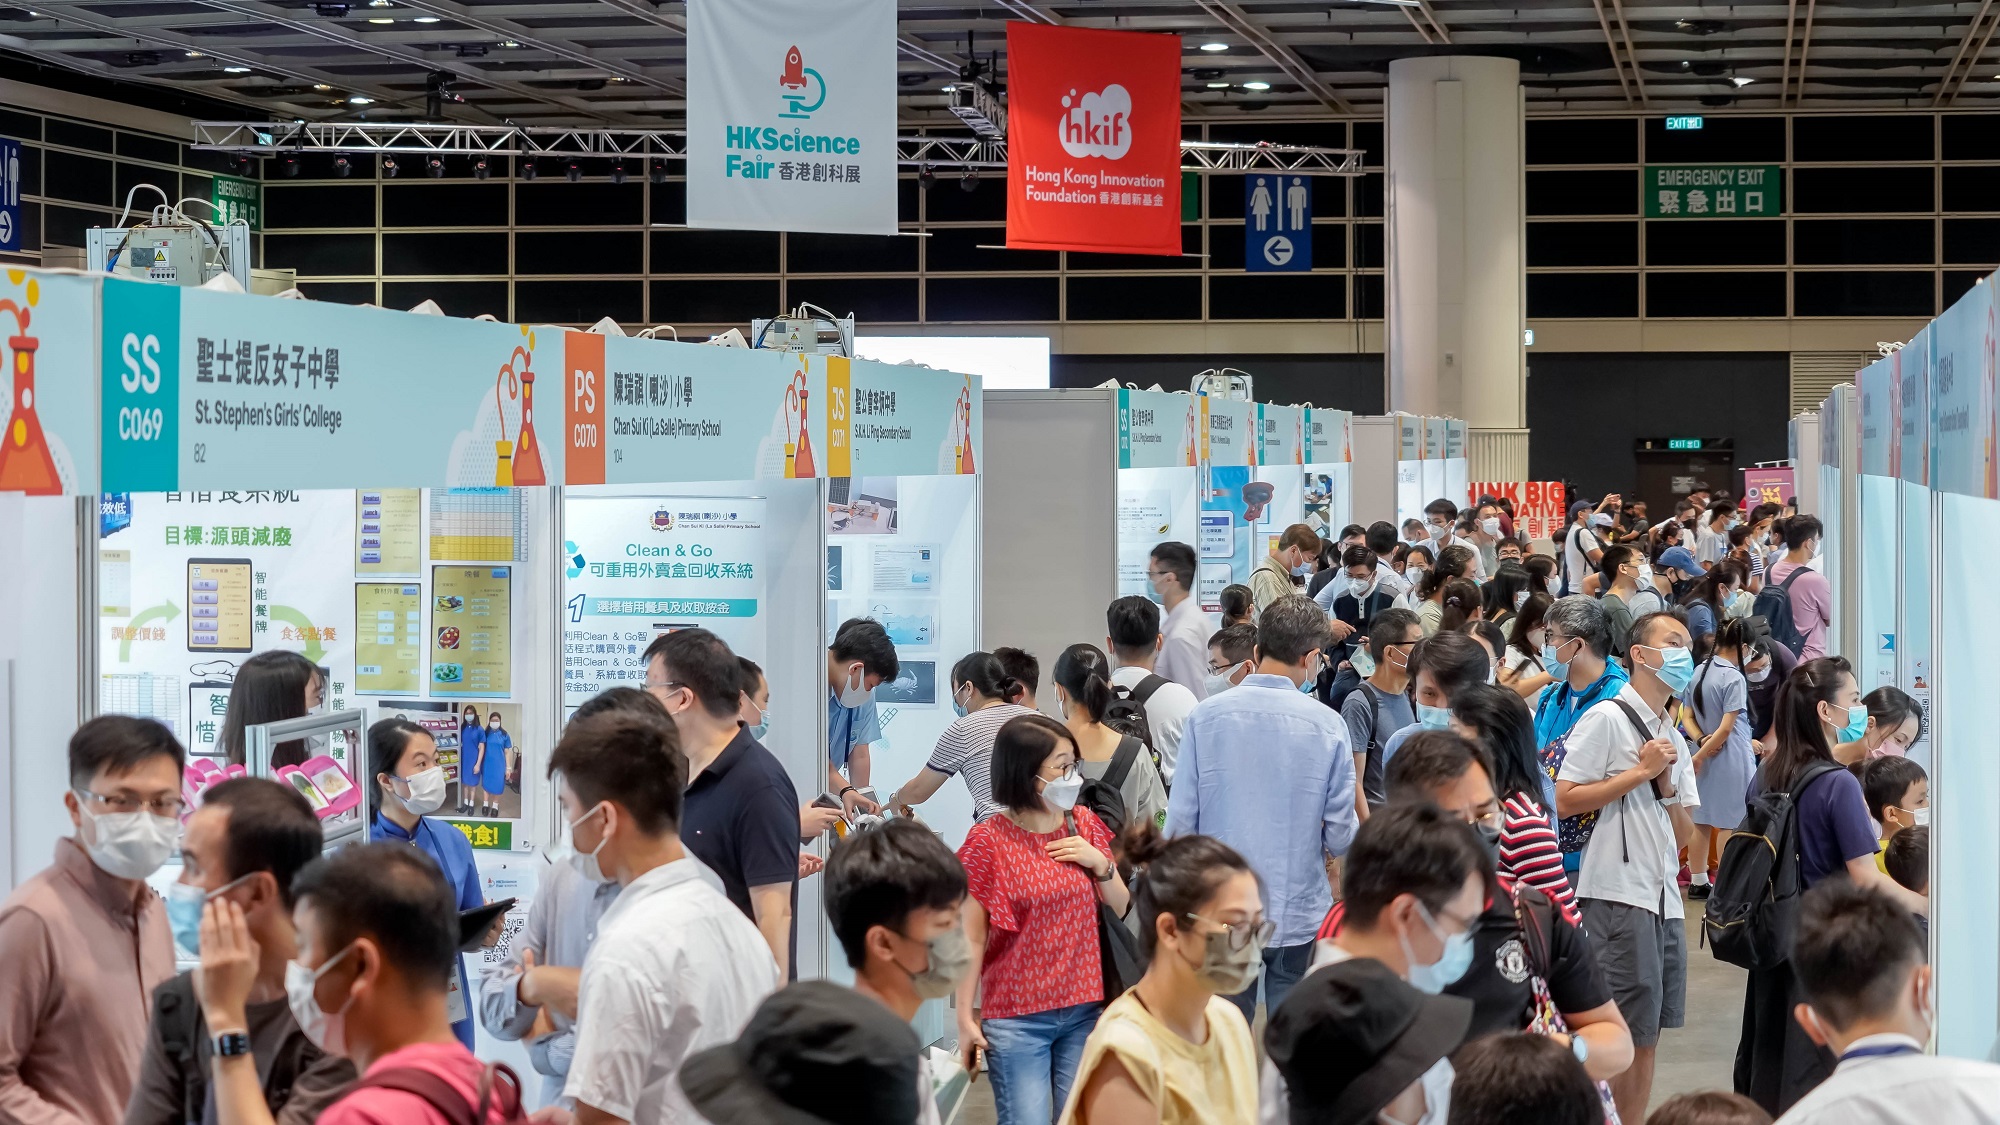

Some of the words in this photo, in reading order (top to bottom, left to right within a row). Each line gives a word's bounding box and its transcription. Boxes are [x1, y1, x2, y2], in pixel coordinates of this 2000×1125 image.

[1065, 110, 1123, 147] hkif
[1666, 117, 1687, 129] EXIT
[726, 125, 860, 155] HKScience
[726, 154, 775, 180] Fair
[778, 161, 861, 184] 香港創科展
[1025, 165, 1061, 187] Hong
[1064, 167, 1097, 188] Kong
[1100, 169, 1165, 188] Innovation
[1657, 169, 1735, 186] EMERGENCY
[1738, 168, 1765, 185] EXIT
[218, 180, 246, 198] EMERGENCY
[246, 184, 257, 199] EXIT
[1026, 185, 1096, 204] Foundation
[1099, 191, 1164, 207] 香港創新基金
[1658, 189, 1764, 214] 緊急出口
[121, 332, 161, 394] SS
[196, 336, 340, 390] 聖士提反女子中學
[574, 369, 596, 414] PS
[855, 388, 896, 416] 聖公會李炳中學
[832, 386, 845, 421] JS
[118, 406, 163, 441] C069
[195, 398, 212, 425] St.
[214, 400, 272, 431] Stephen's
[274, 402, 302, 428] Girls'
[303, 403, 342, 434] College
[574, 423, 597, 448] C070
[613, 416, 631, 436] Chan
[631, 417, 642, 436] Sui
[642, 418, 649, 436] Ki
[649, 416, 659, 439] (La
[660, 417, 677, 440] Salle)
[678, 418, 702, 440] Primary
[702, 419, 721, 437] School
[855, 423, 867, 439] S.K.H.
[871, 424, 880, 443] Ping
[880, 425, 899, 443] Secondary
[900, 425, 912, 440] School
[193, 442, 206, 463] 82
[1670, 439, 1686, 449] EXIT
[1687, 439, 1700, 449] 出口
[613, 449, 623, 463] 104
[1525, 482, 1565, 504] BIG
[625, 543, 670, 558] Clean
[675, 544, 687, 557] &
[690, 543, 713, 558] Go
[590, 562, 754, 579] 可重用外賣盒回收系統
[254, 571, 268, 634] 智能餐牌
[596, 600, 731, 614] 選擇借用餐具及收取按金
[111, 626, 166, 642] 調整價錢
[280, 626, 338, 642] 食客點餐
[613, 632, 620, 641] &
[613, 657, 620, 667] &
[332, 681, 345, 760] 智能物櫃
